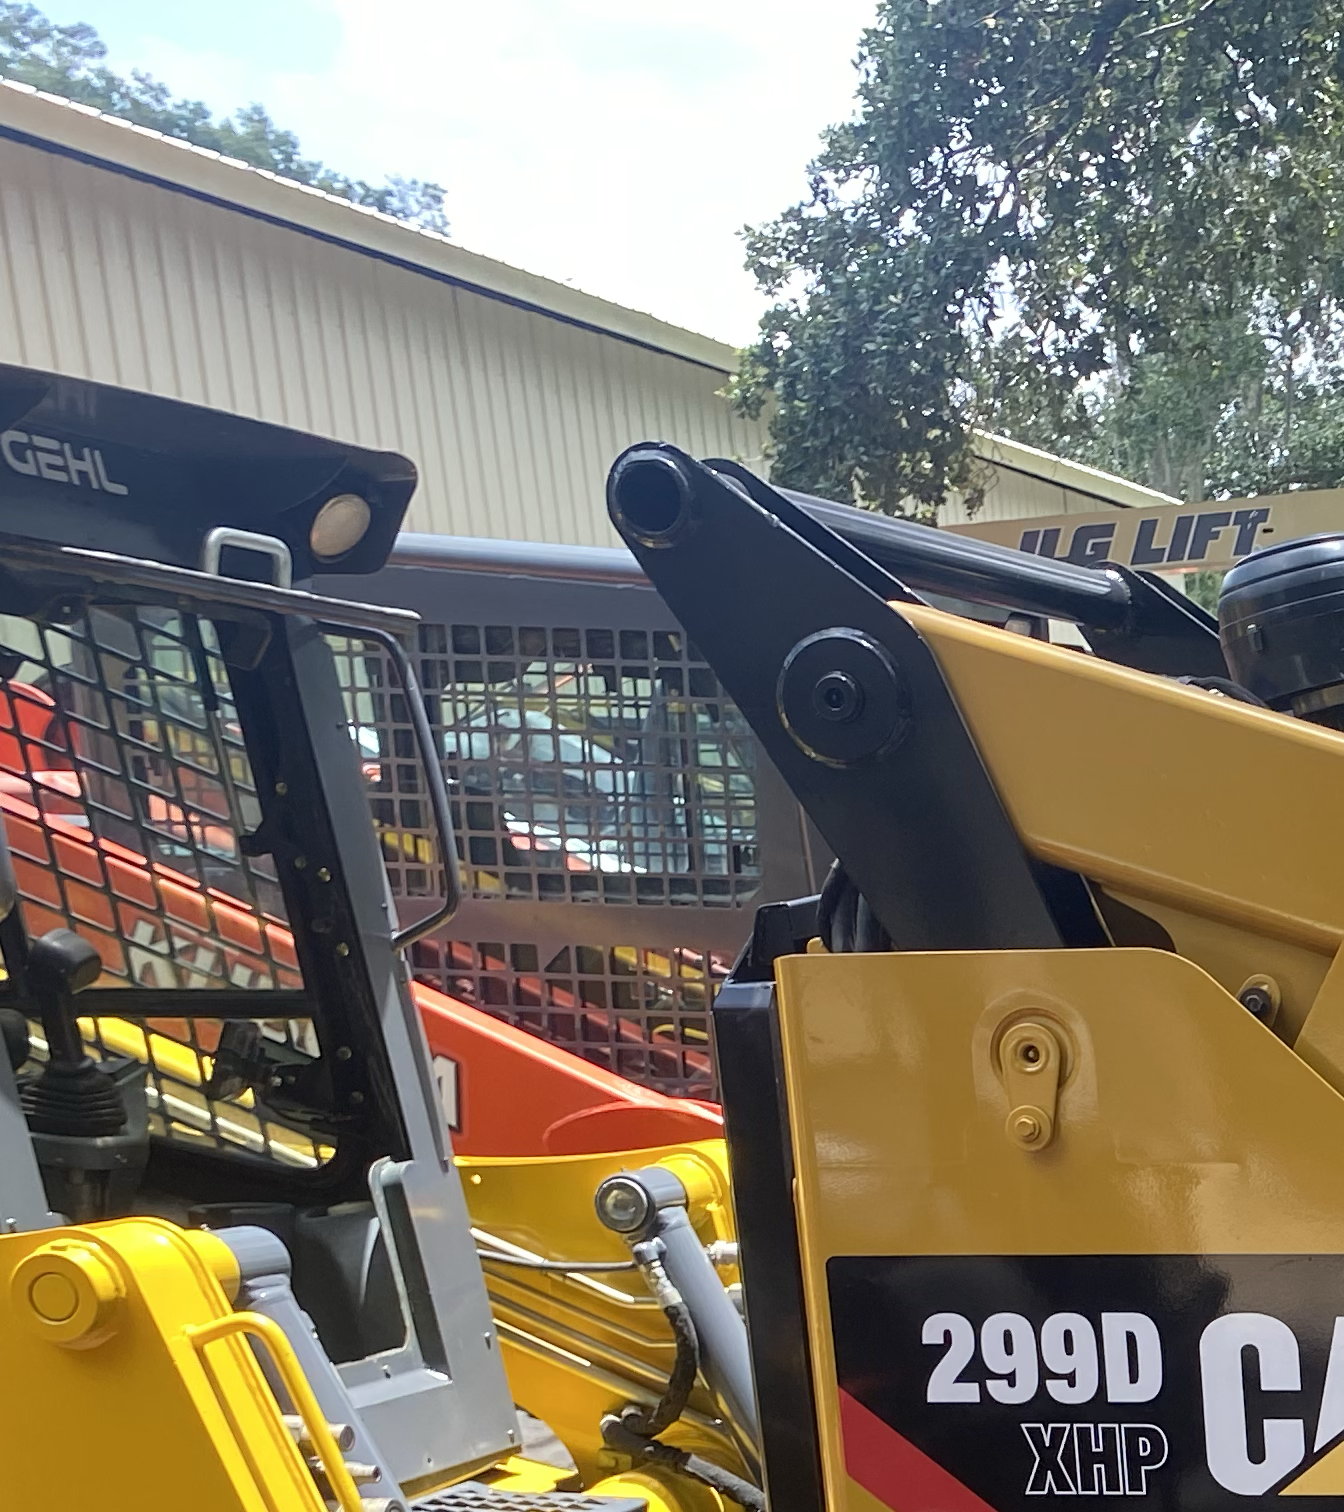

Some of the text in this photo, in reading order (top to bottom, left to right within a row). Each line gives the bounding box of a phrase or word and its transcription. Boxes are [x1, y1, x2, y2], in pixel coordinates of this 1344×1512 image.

[0, 429, 129, 496] GEHL
[1130, 507, 1271, 566] LIFT
[921, 1311, 1164, 1405] 299D
[1020, 1422, 1169, 1497] XHP
